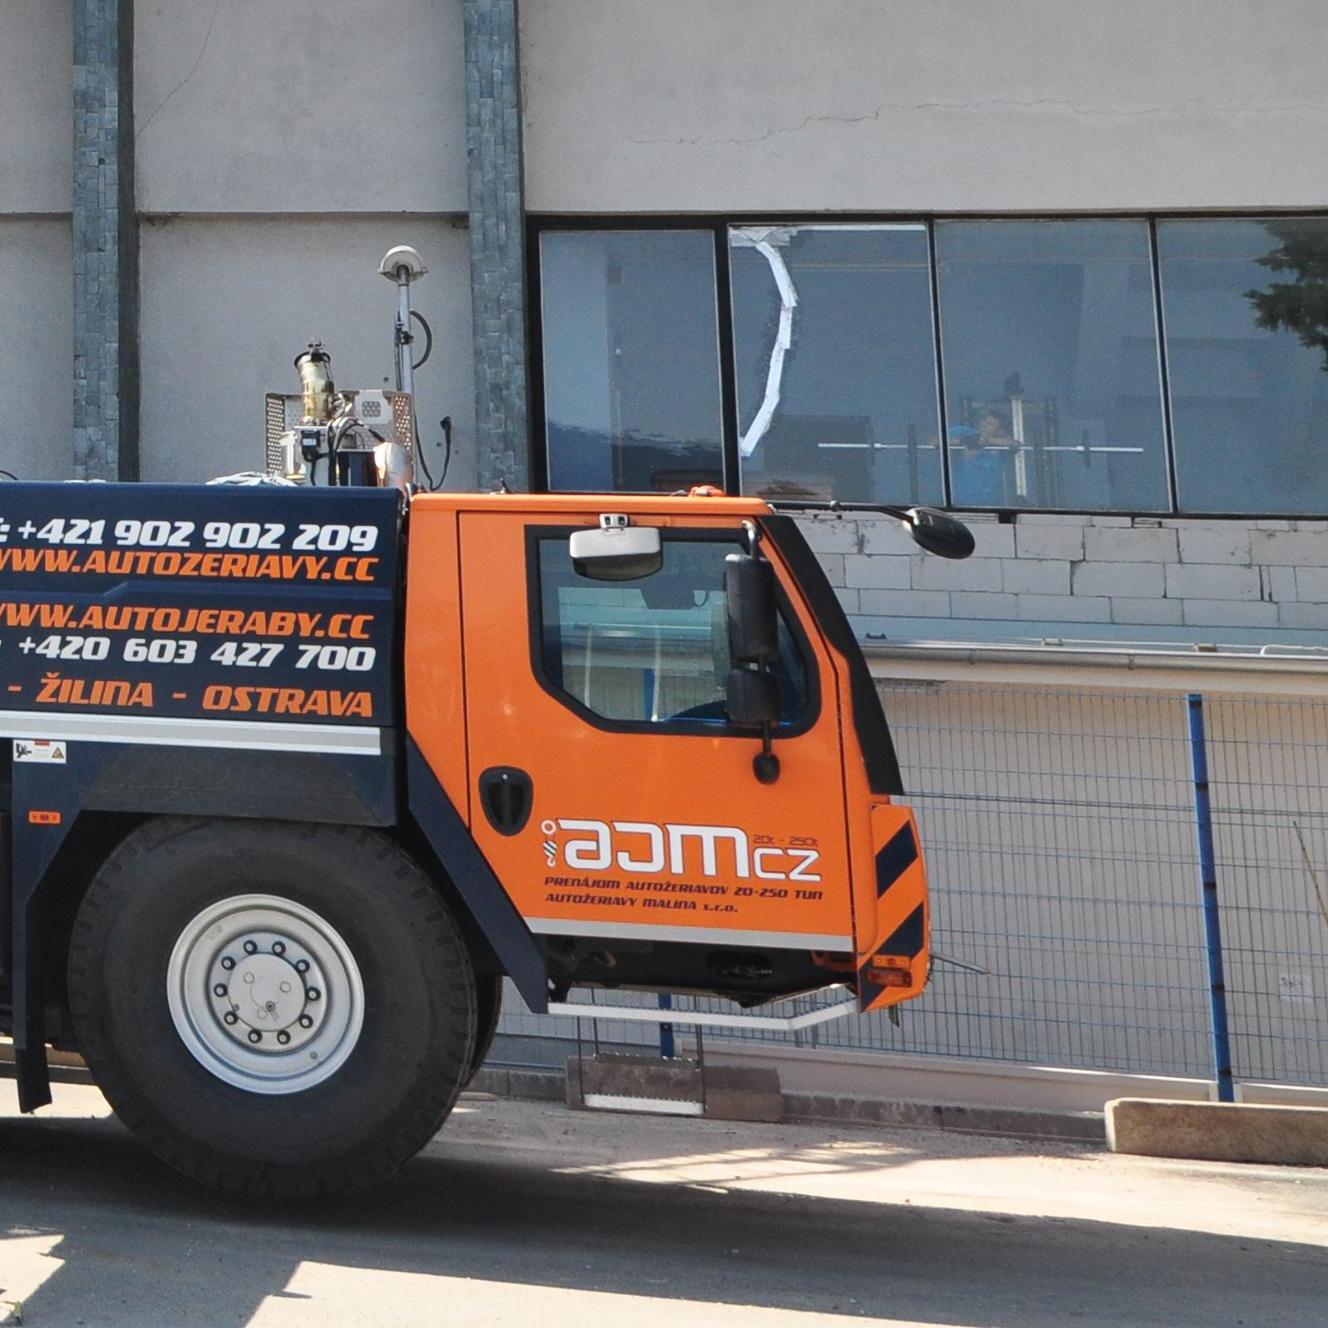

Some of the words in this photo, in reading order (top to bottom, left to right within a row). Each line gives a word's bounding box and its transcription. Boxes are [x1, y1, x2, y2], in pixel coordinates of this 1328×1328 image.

[18, 519, 105, 545] +421
[114, 520, 195, 547] 902
[203, 522, 286, 550] 902
[292, 524, 378, 552] 209
[19, 635, 110, 661] +420
[123, 639, 197, 664] 603
[210, 642, 285, 668] 427
[295, 644, 376, 671] 700
[36, 672, 153, 708] ŽILINA
[202, 684, 373, 717] OSTRAVA
[544, 876, 620, 890] PRENÁJOM
[626, 880, 729, 896] AUTOŽERIAVOV
[733, 887, 788, 899] 20-250
[794, 889, 823, 900] TUN
[545, 892, 639, 908] AUTOŽERIAVY
[642, 898, 697, 911] MALINA
